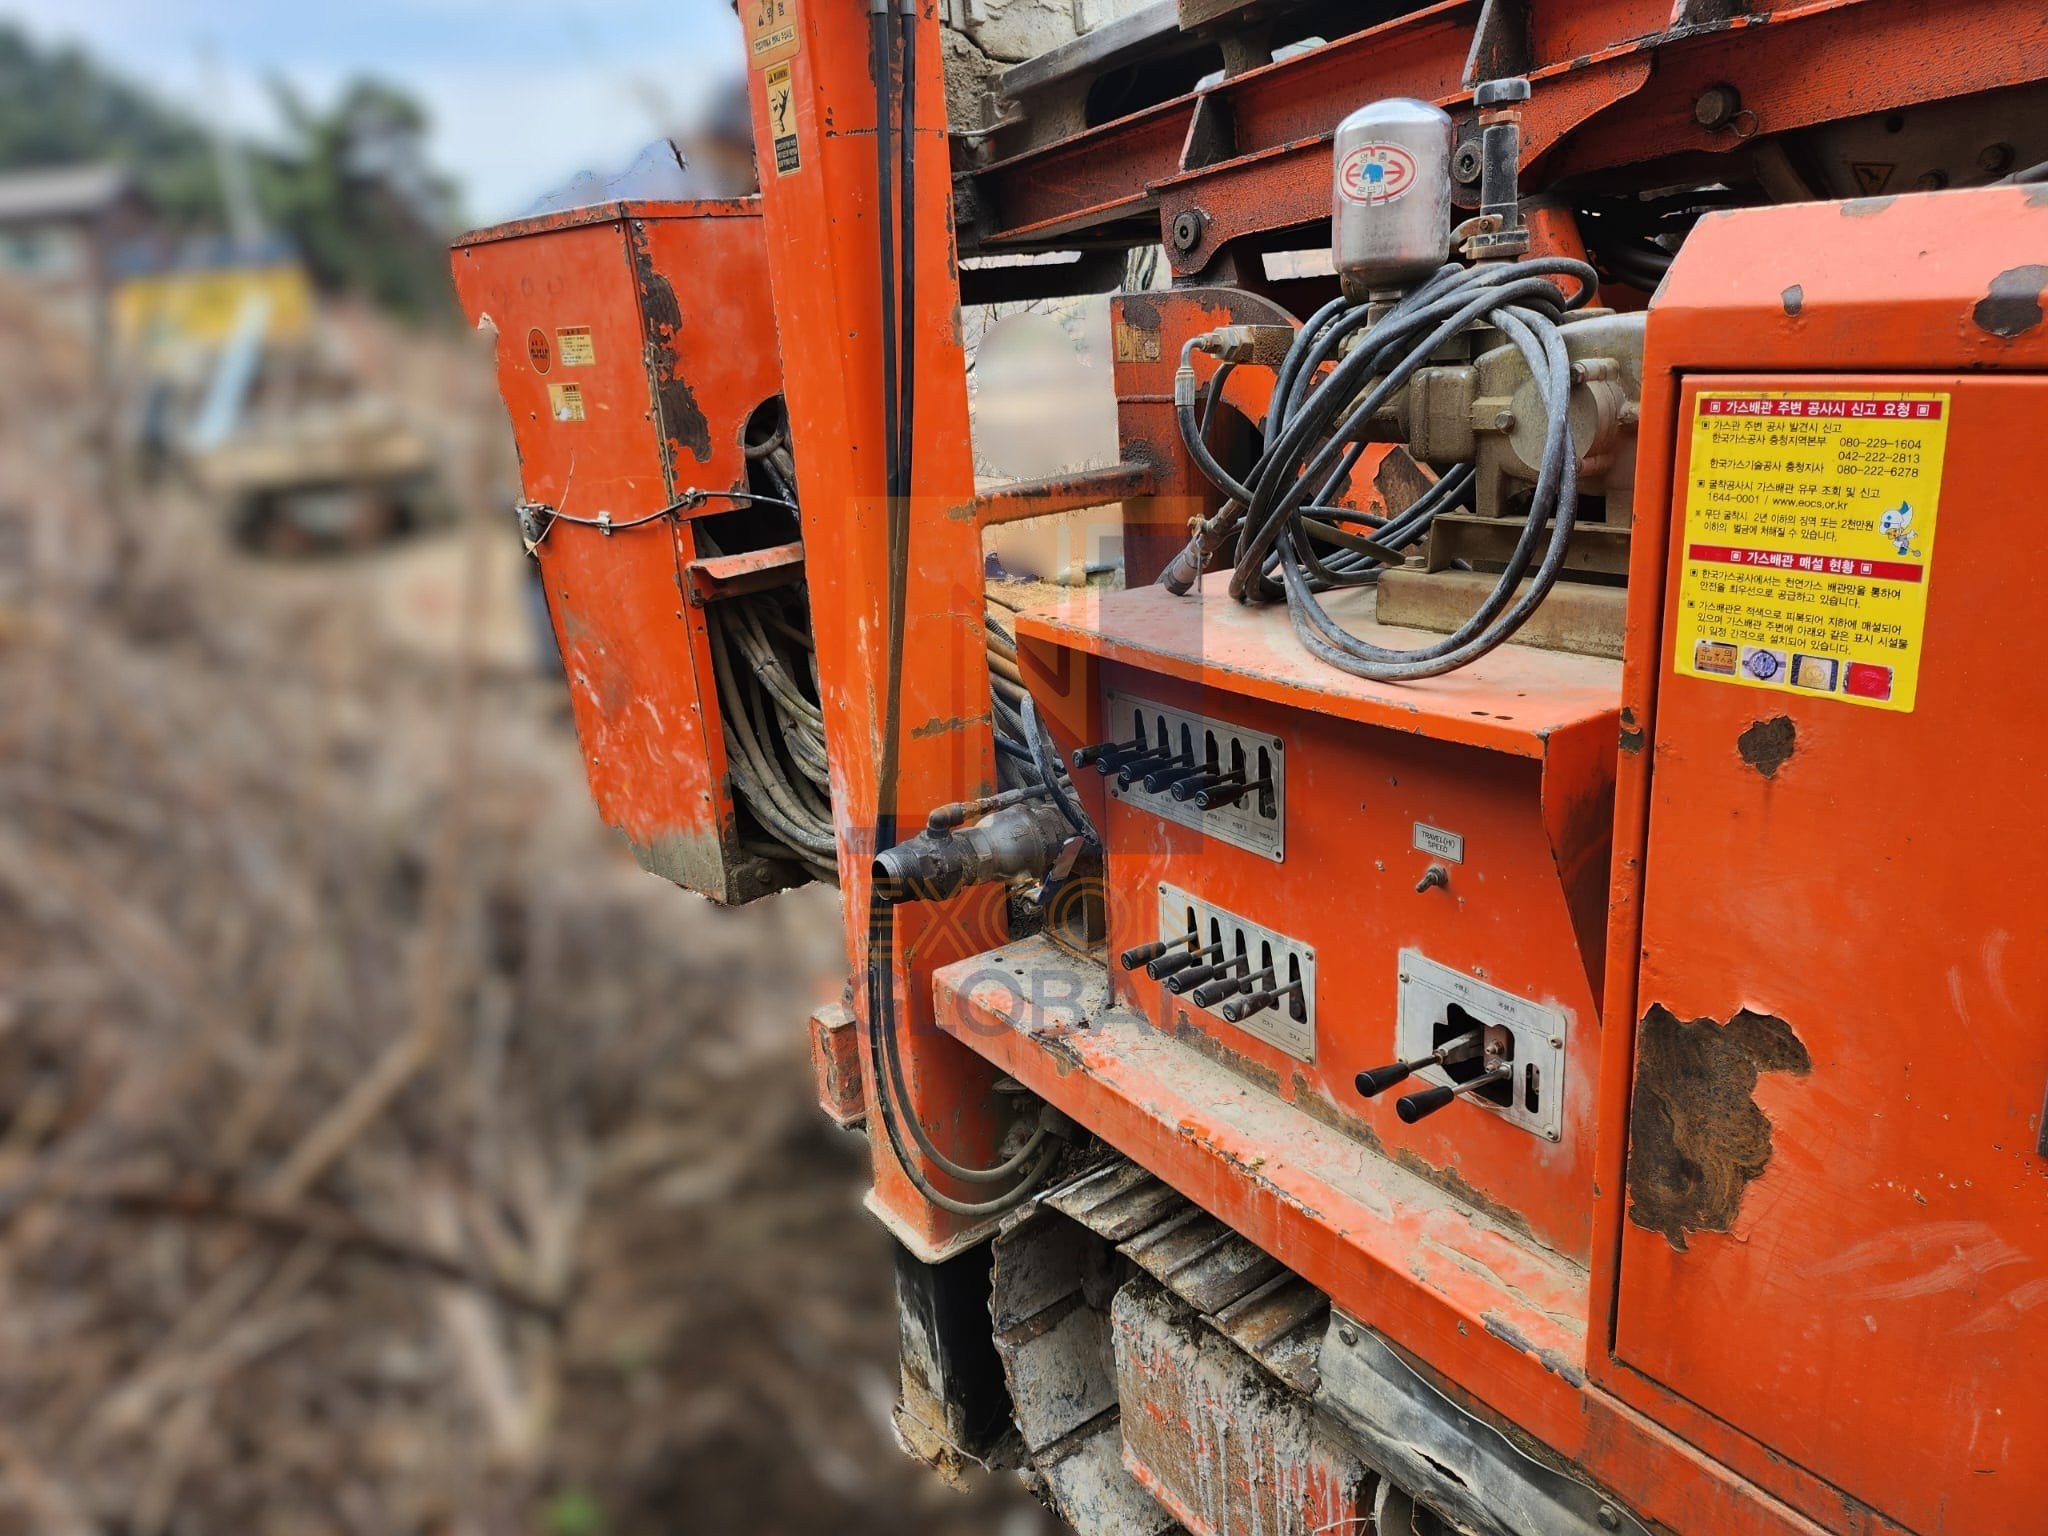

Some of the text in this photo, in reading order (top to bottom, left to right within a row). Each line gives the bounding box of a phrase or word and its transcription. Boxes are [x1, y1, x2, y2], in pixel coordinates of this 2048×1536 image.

[1726, 401, 1910, 417] 가스배관 주변 공사시 신고 요청
[1714, 421, 1842, 434] 가스관 주변 공사 발견시 신고
[1712, 433, 1922, 449] 한국가스공사 충청지역본부 080-229-1604
[1838, 451, 1920, 464] 042-222-2813
[1710, 458, 1919, 478] 한국가스기술공사 충청지사 080-222-6278
[1709, 480, 1753, 491] 굴착공사시
[1757, 482, 1794, 493] 가스배관
[1799, 484, 1817, 495] 유무
[1822, 485, 1841, 497] 조회
[1861, 488, 1880, 498] 신고
[1708, 493, 1759, 504] 1644-0001
[1773, 498, 1848, 510] www.eocs.or.kr
[1705, 509, 1874, 531] 무단 굴착시 2년 이하의 징역 또는 2천만원
[1704, 522, 1727, 532] 이하의
[1734, 524, 1758, 535] 벌금에
[1761, 526, 1786, 538] 처해질
[1789, 529, 1797, 538] 수
[1746, 551, 1854, 574] 가스배관 매설 현황
[1702, 568, 1901, 600] 한국가스공사에서는 천연가스 배관망을 통하여
[1700, 581, 1861, 609] 안전을 최우선으로 공급하고 있습니다.
[1698, 601, 1902, 635] 가스배관은 적색으로 피복되어 지하에 매설되어
[1697, 613, 1908, 650] 있으며 가스배관 주변에 아래와 같은 표시 시설물
[1697, 625, 1851, 655] 이 일정 간격으로 설치되어 있습니다.
[1428, 840, 1448, 853] SPEED
